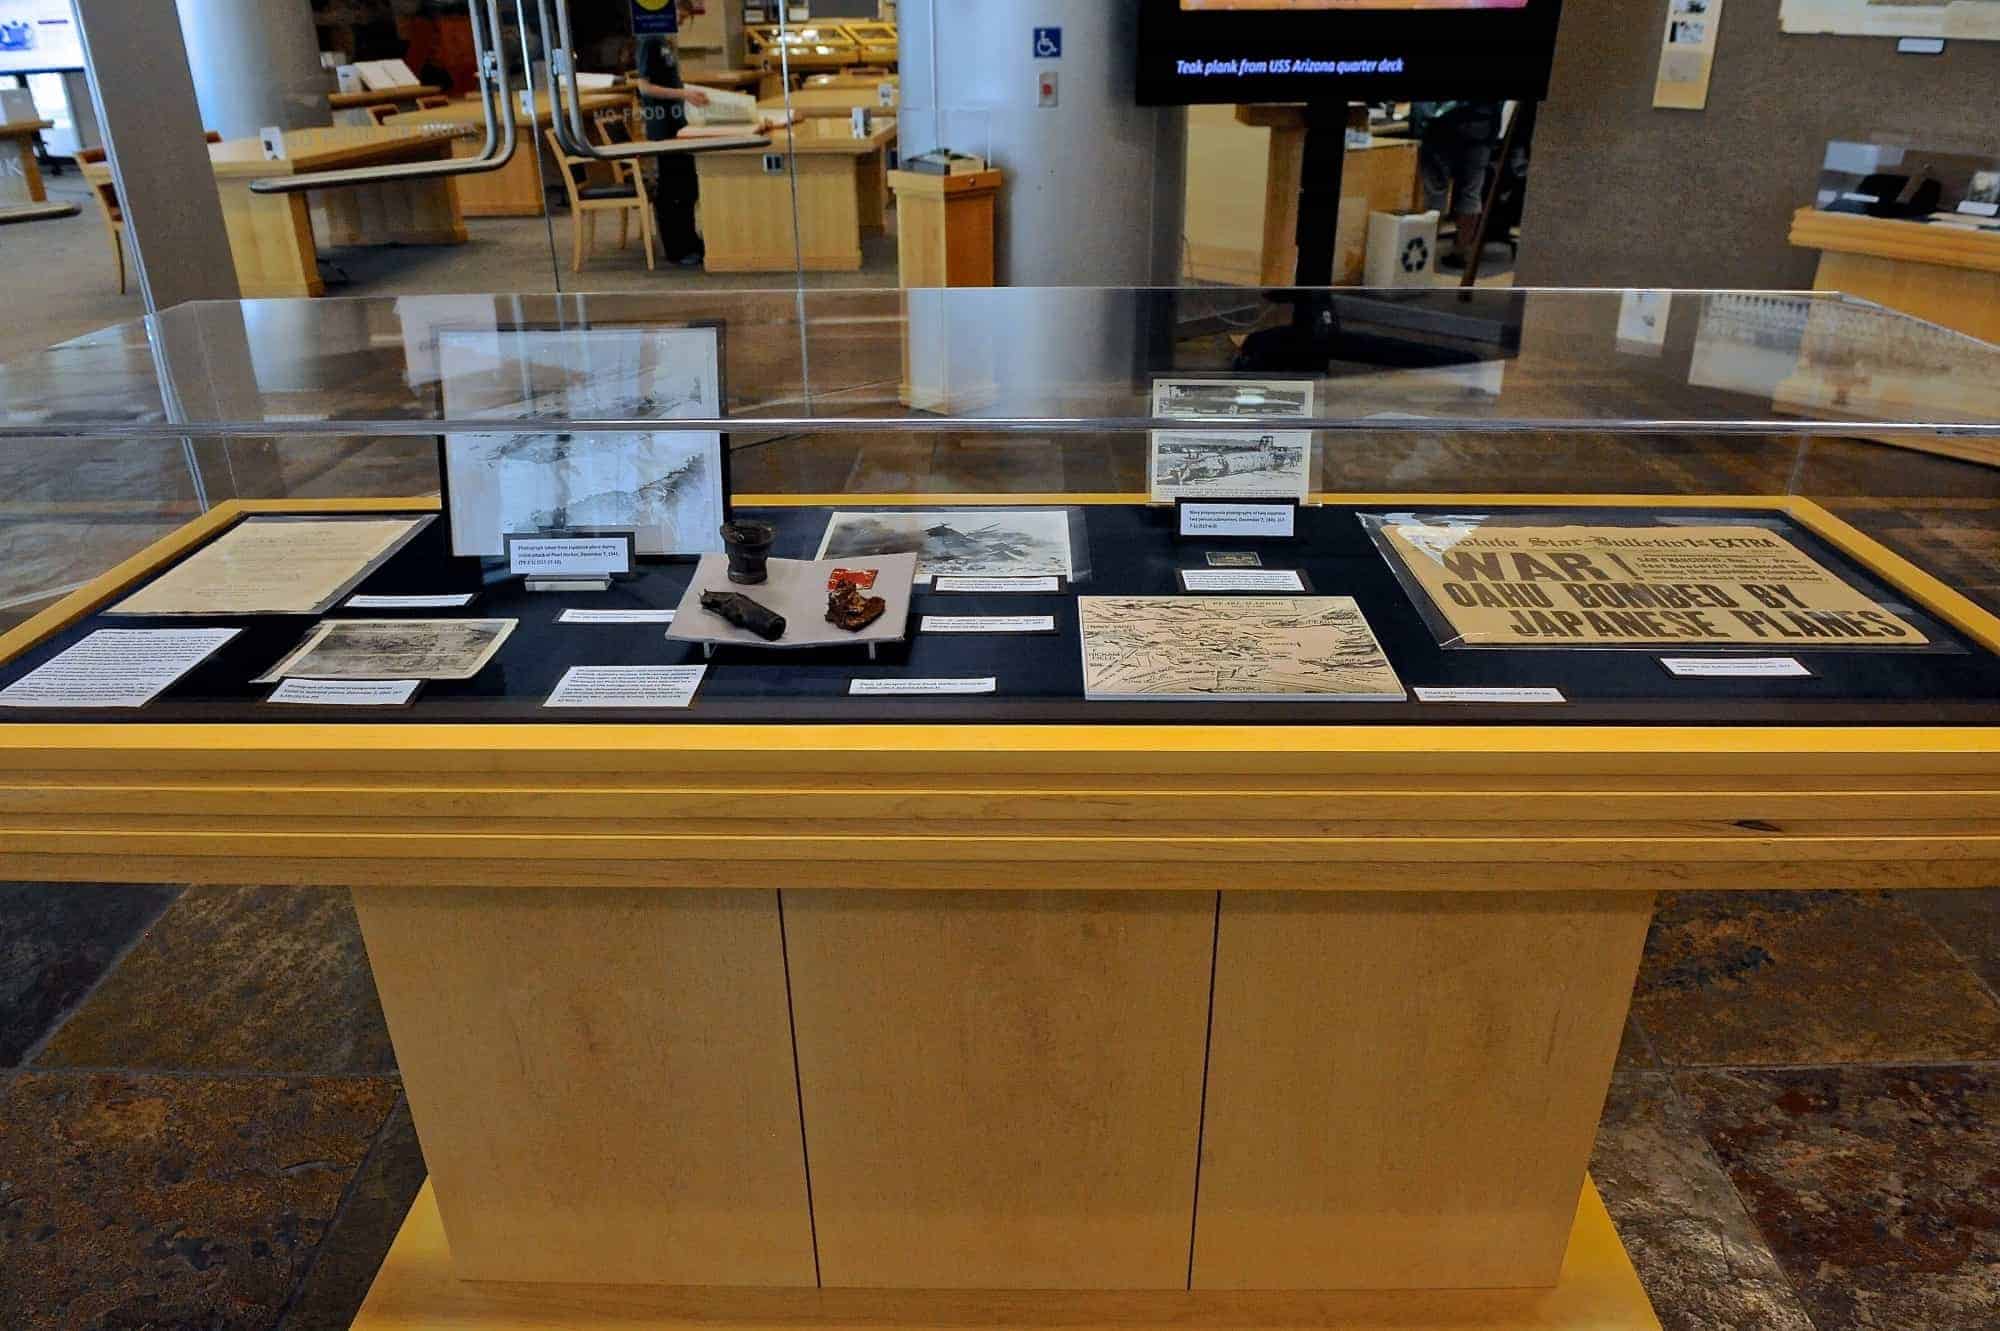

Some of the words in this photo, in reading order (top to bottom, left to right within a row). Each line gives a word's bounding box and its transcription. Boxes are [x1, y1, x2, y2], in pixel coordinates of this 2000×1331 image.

[1176, 60, 1202, 73] Teak
[1204, 59, 1237, 76] plank
[1237, 58, 1267, 76] from
[1269, 60, 1290, 73] USS
[1292, 58, 1335, 73] Arizona
[1336, 60, 1377, 75] quarter
[1378, 58, 1403, 73] deck
[1709, 538, 1779, 549] EXTRA
[1441, 551, 1645, 581] WAR!
[1442, 582, 1555, 608] OAHU
[1561, 582, 1741, 609] BOMBED
[1740, 583, 1810, 609] BY
[1508, 610, 1731, 637] JAPANESE
[1727, 610, 1907, 638] PLANES
